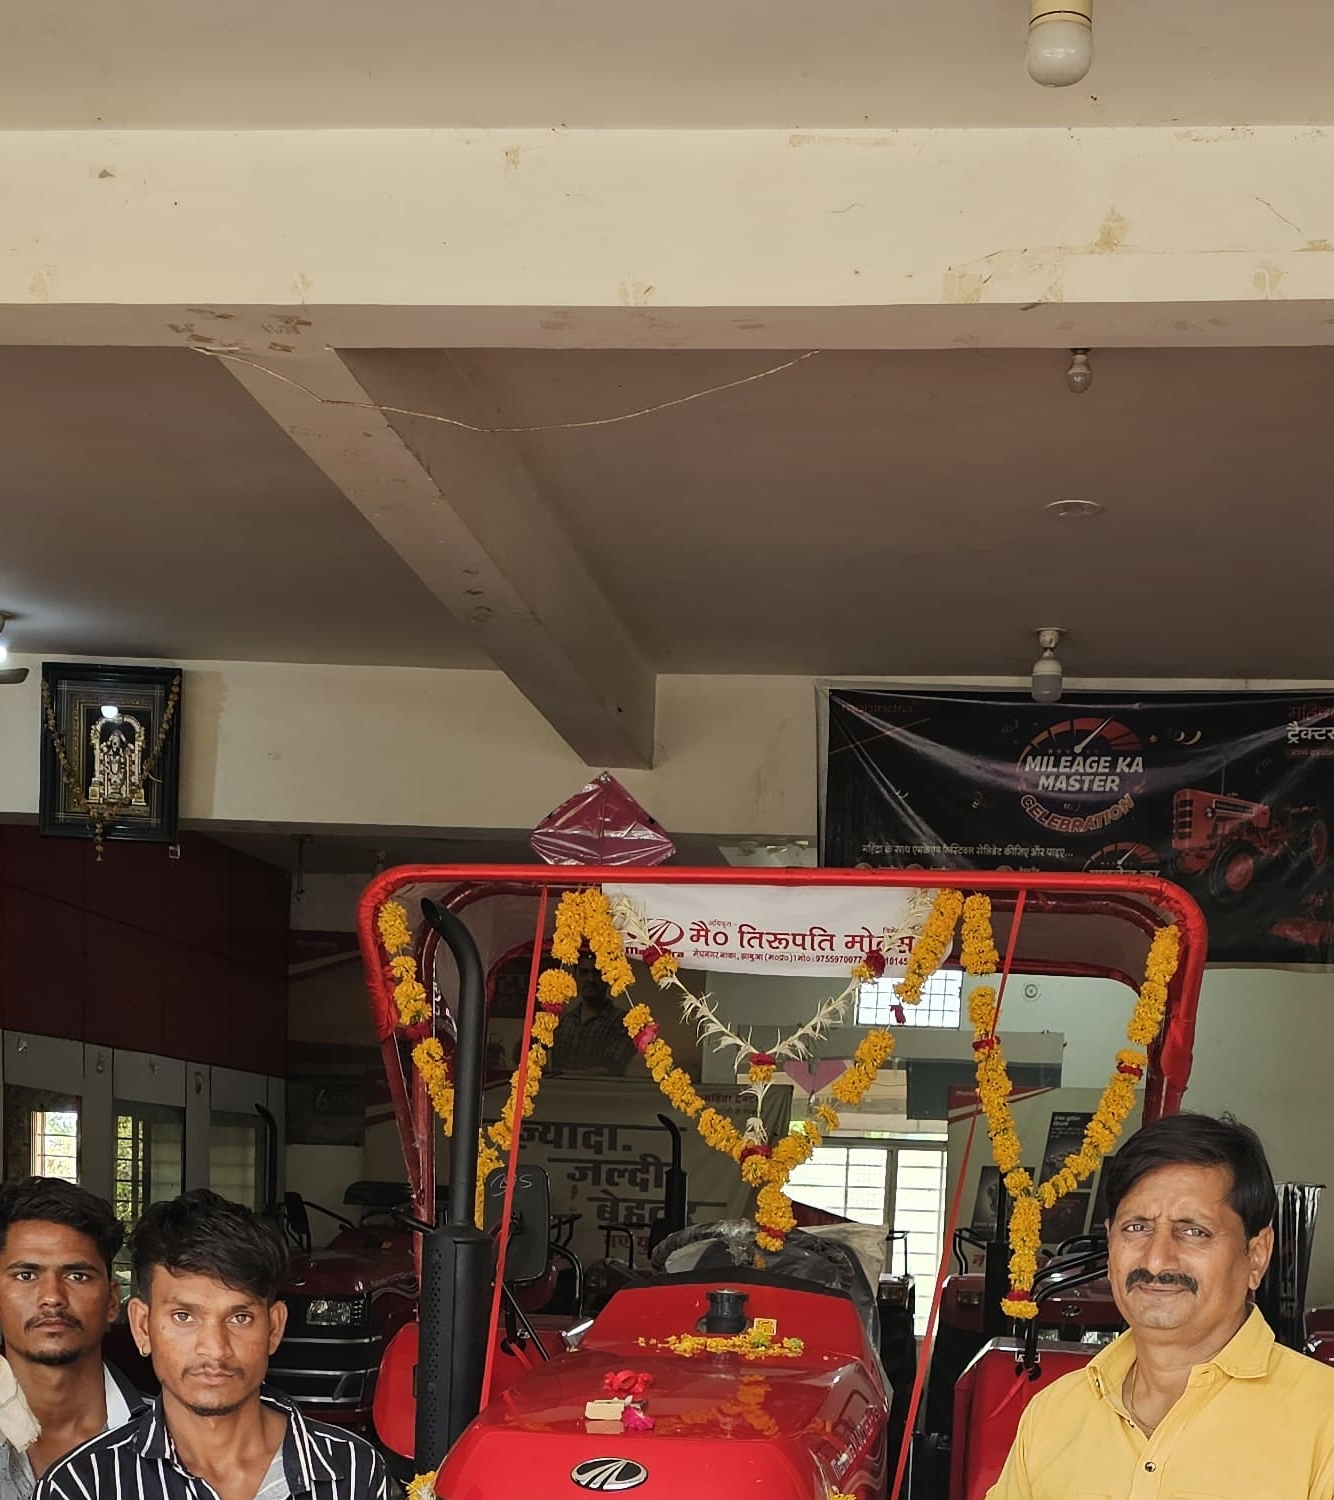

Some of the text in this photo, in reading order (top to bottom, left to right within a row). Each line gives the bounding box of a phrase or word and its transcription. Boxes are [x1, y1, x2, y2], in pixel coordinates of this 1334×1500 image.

[1025, 755, 1145, 775] MILEAGE KA
[1037, 774, 1121, 793] MASTER
[1020, 792, 1135, 834] CELEBRATION
